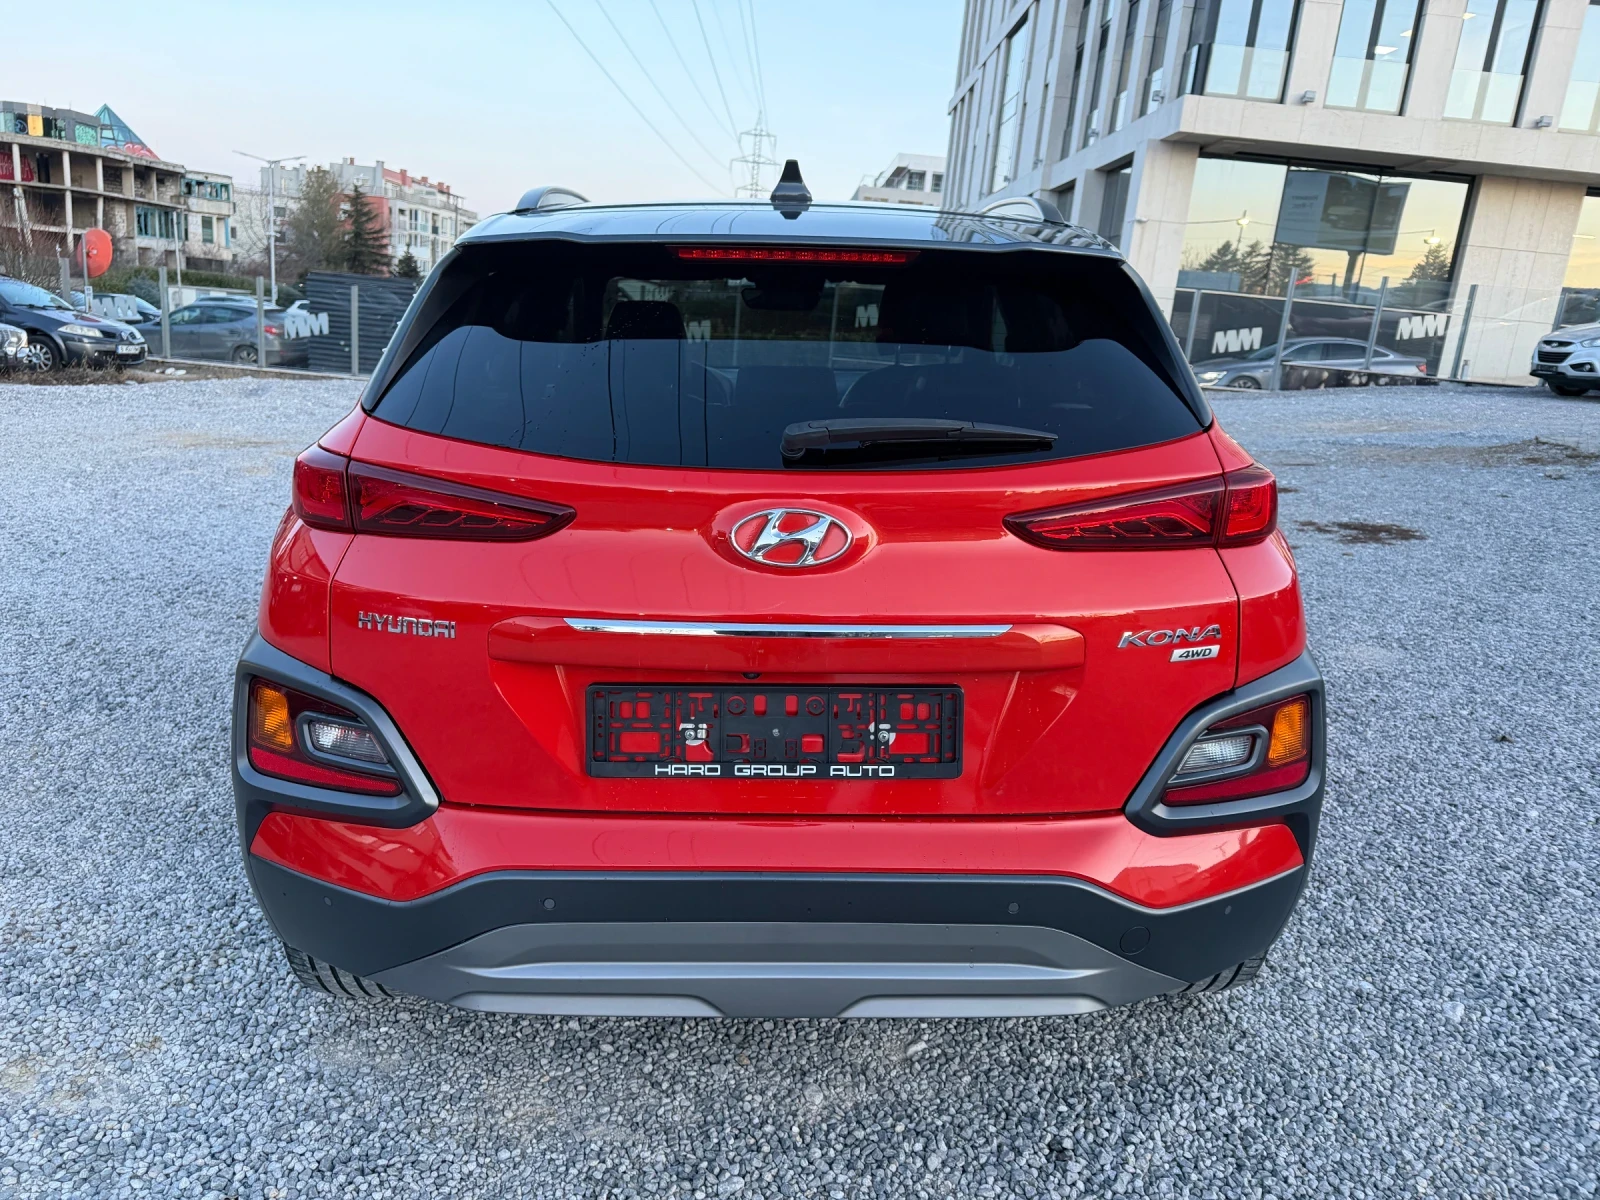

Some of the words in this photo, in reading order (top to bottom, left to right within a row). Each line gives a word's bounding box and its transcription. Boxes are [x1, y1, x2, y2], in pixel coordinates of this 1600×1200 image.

[358, 611, 456, 639] HYUNDAI
[1117, 624, 1222, 648] KONA
[1178, 647, 1213, 659] 4WD
[654, 764, 721, 776] HARD
[734, 765, 817, 776] GROUP
[829, 765, 895, 777] AUTO
